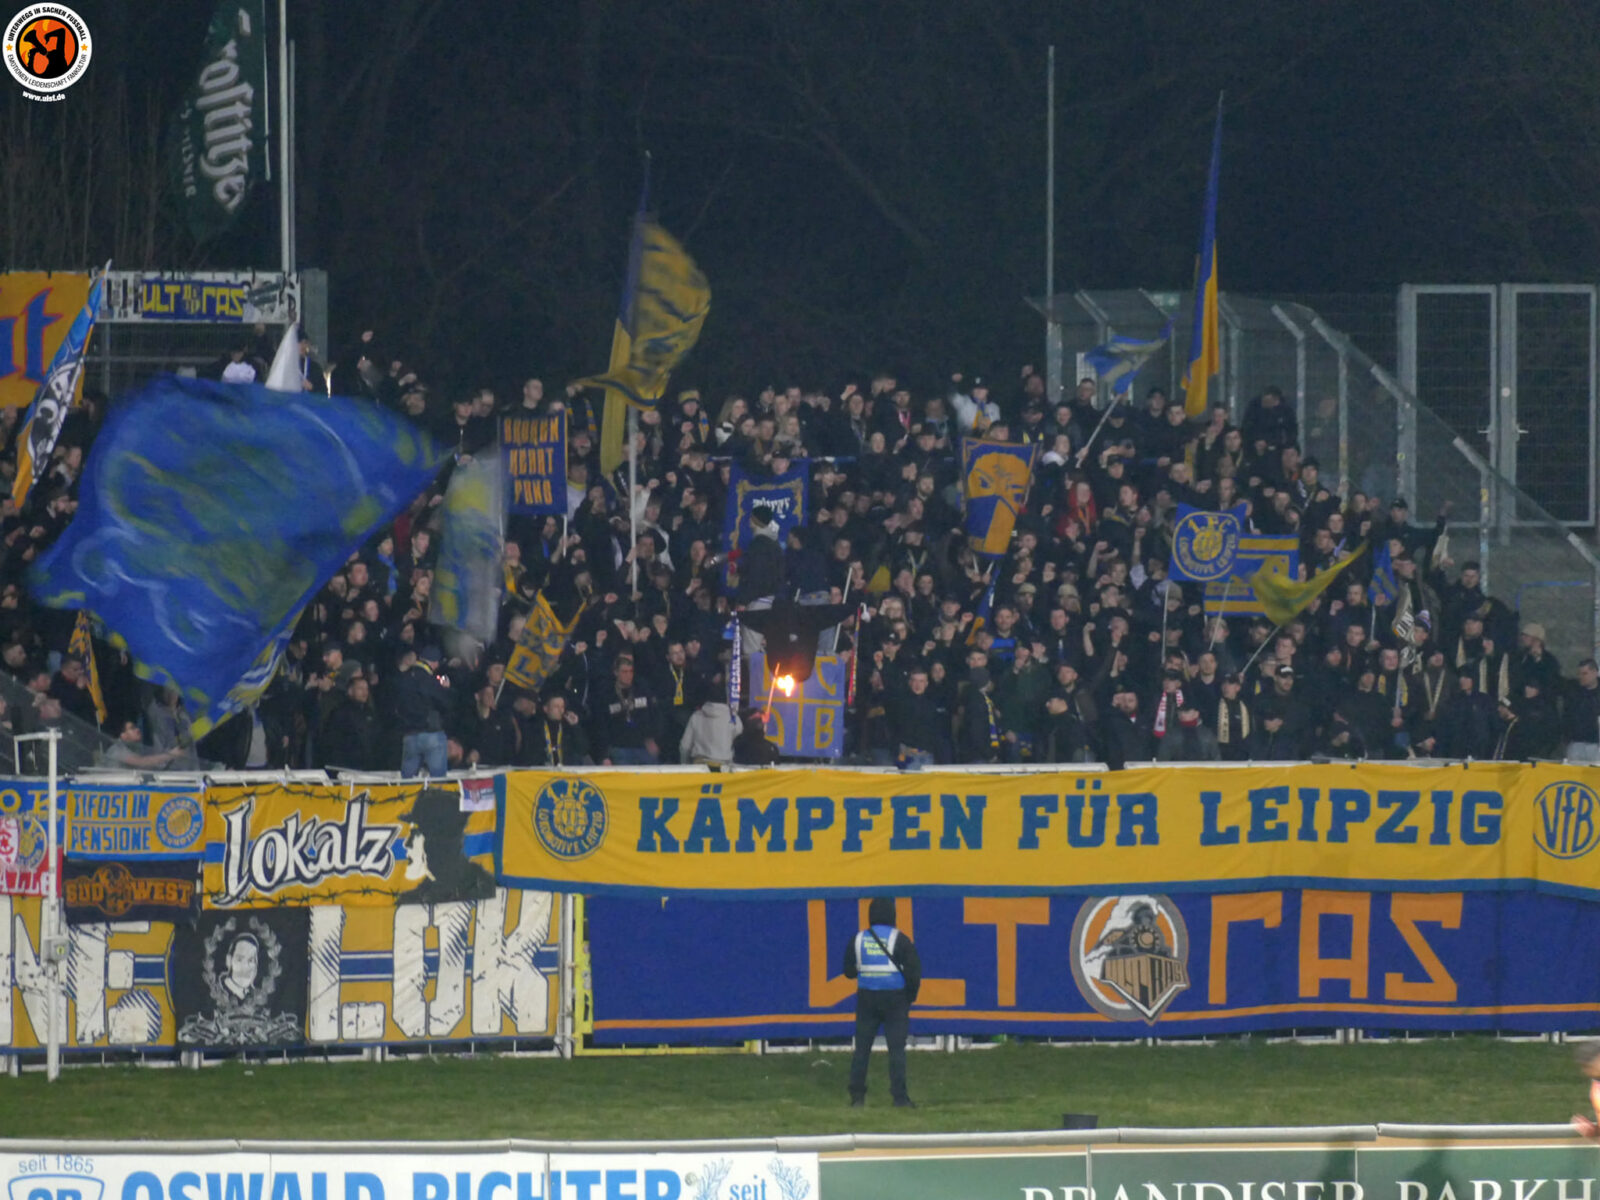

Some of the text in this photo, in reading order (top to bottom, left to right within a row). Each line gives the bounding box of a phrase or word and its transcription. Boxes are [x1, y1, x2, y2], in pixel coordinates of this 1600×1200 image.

[73, 792, 128, 819] TIFOSI
[131, 792, 150, 818] IN
[636, 779, 1504, 853] KÄMPFEN FÜR LEIPZIG
[1540, 785, 1594, 854] VfB
[71, 826, 152, 851] PENSIONE
[131, 880, 191, 904] WEST
[309, 887, 553, 1043] LOK
[18, 1153, 94, 1173] seit 1865
[728, 1174, 767, 1200] seit
